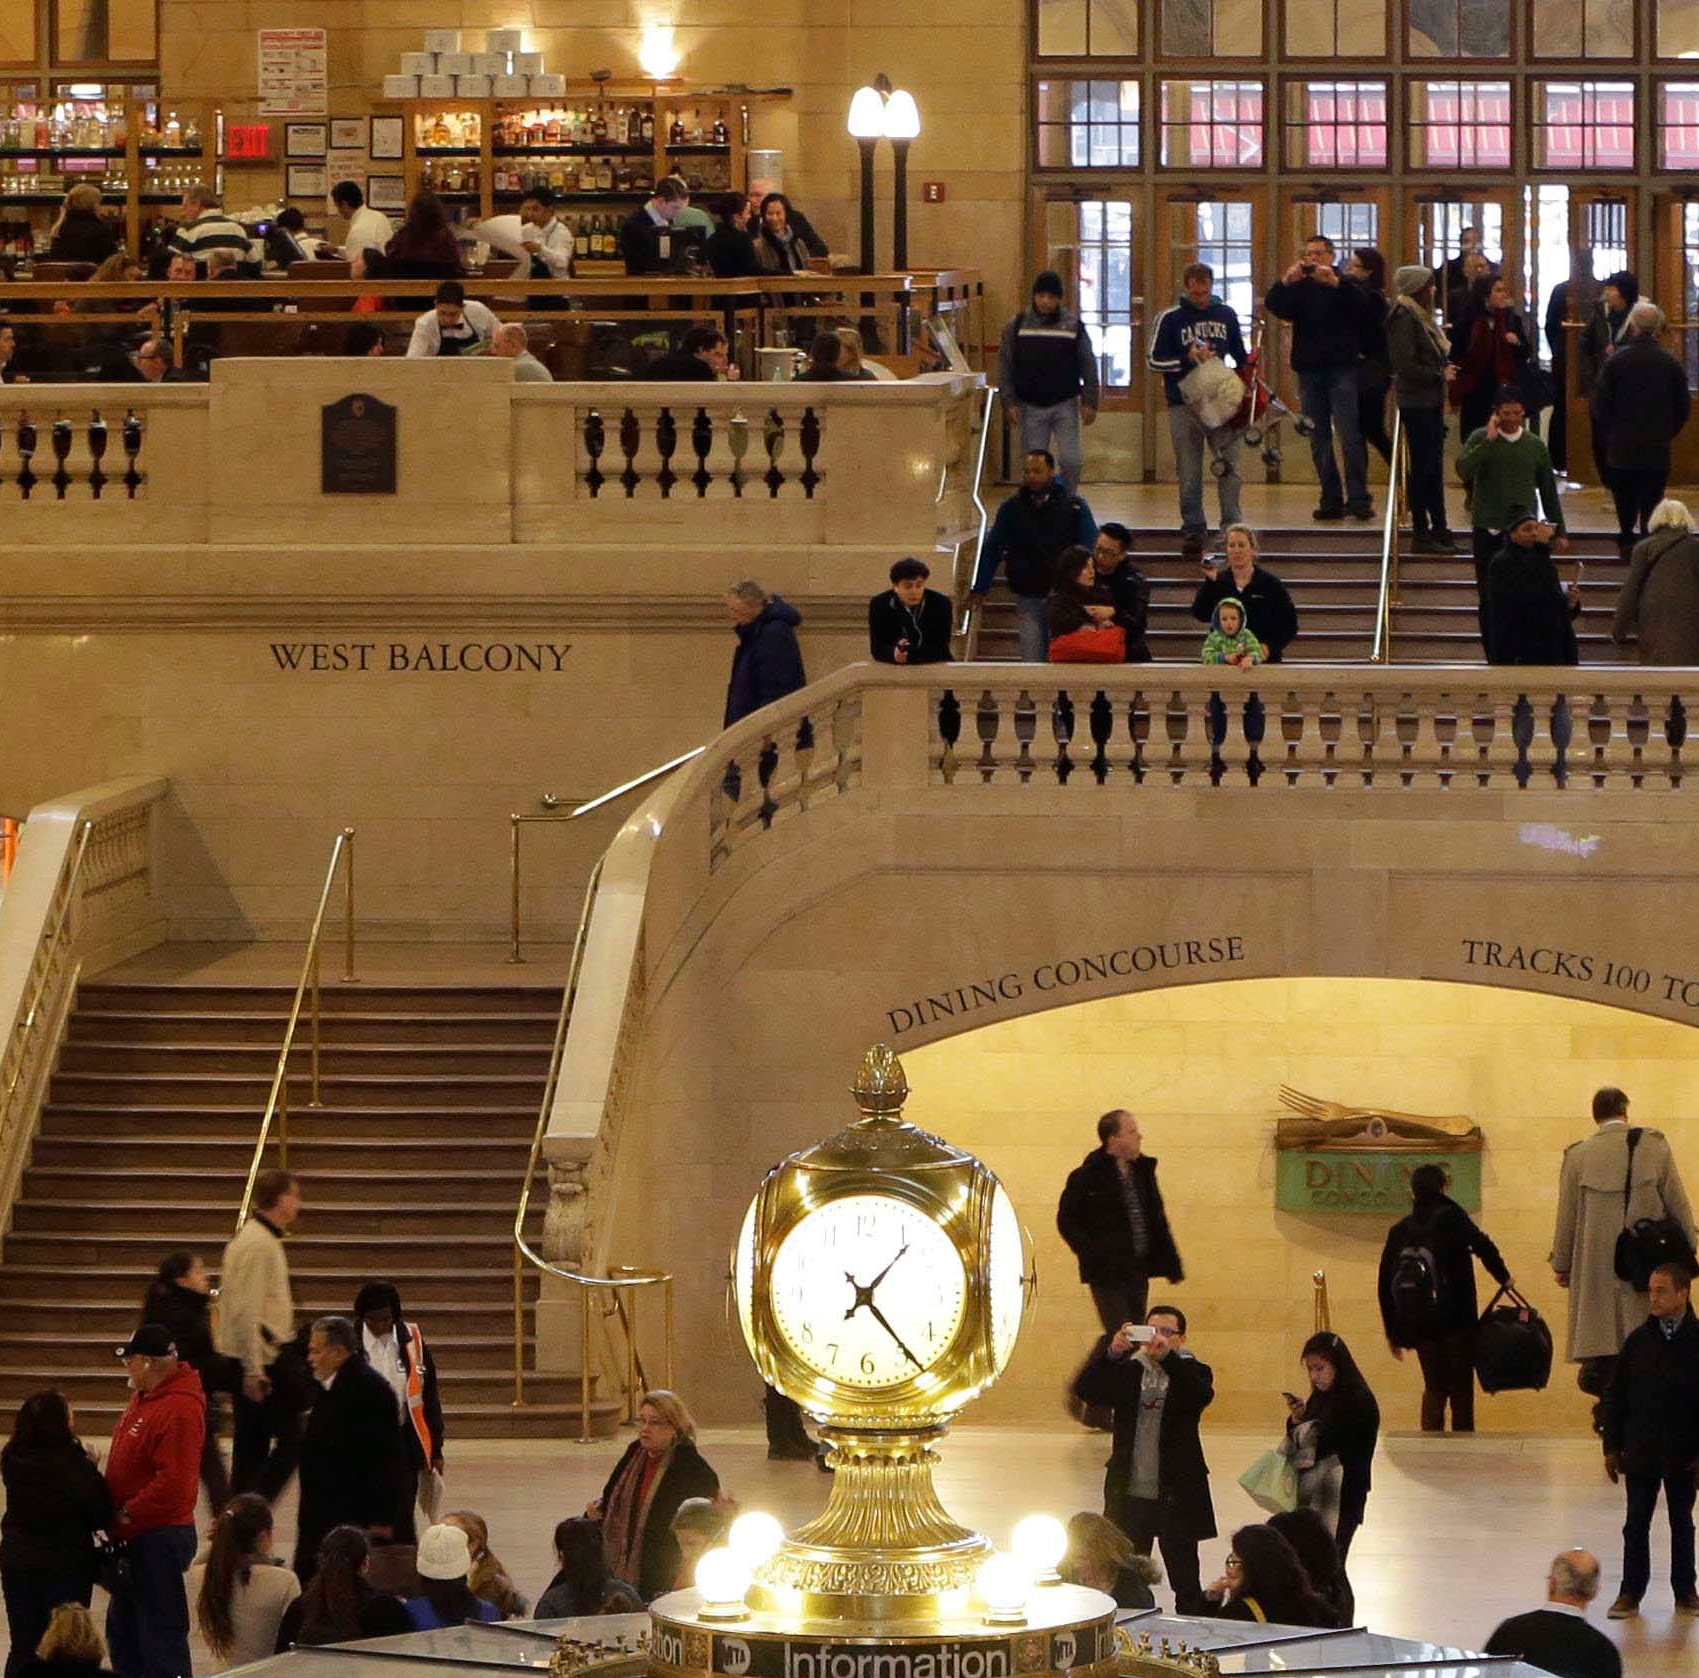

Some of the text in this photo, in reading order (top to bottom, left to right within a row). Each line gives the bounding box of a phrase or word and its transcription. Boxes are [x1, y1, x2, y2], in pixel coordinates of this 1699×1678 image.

[1182, 320, 1228, 346] CANUCKS
[269, 643, 573, 673] WEST BALCONY
[1462, 938, 1594, 981] TRACKS
[1603, 963, 1651, 993] 100
[886, 936, 1245, 1035] DINING CONCOURSE
[826, 1343, 839, 1365] 7
[860, 1352, 875, 1375] 6
